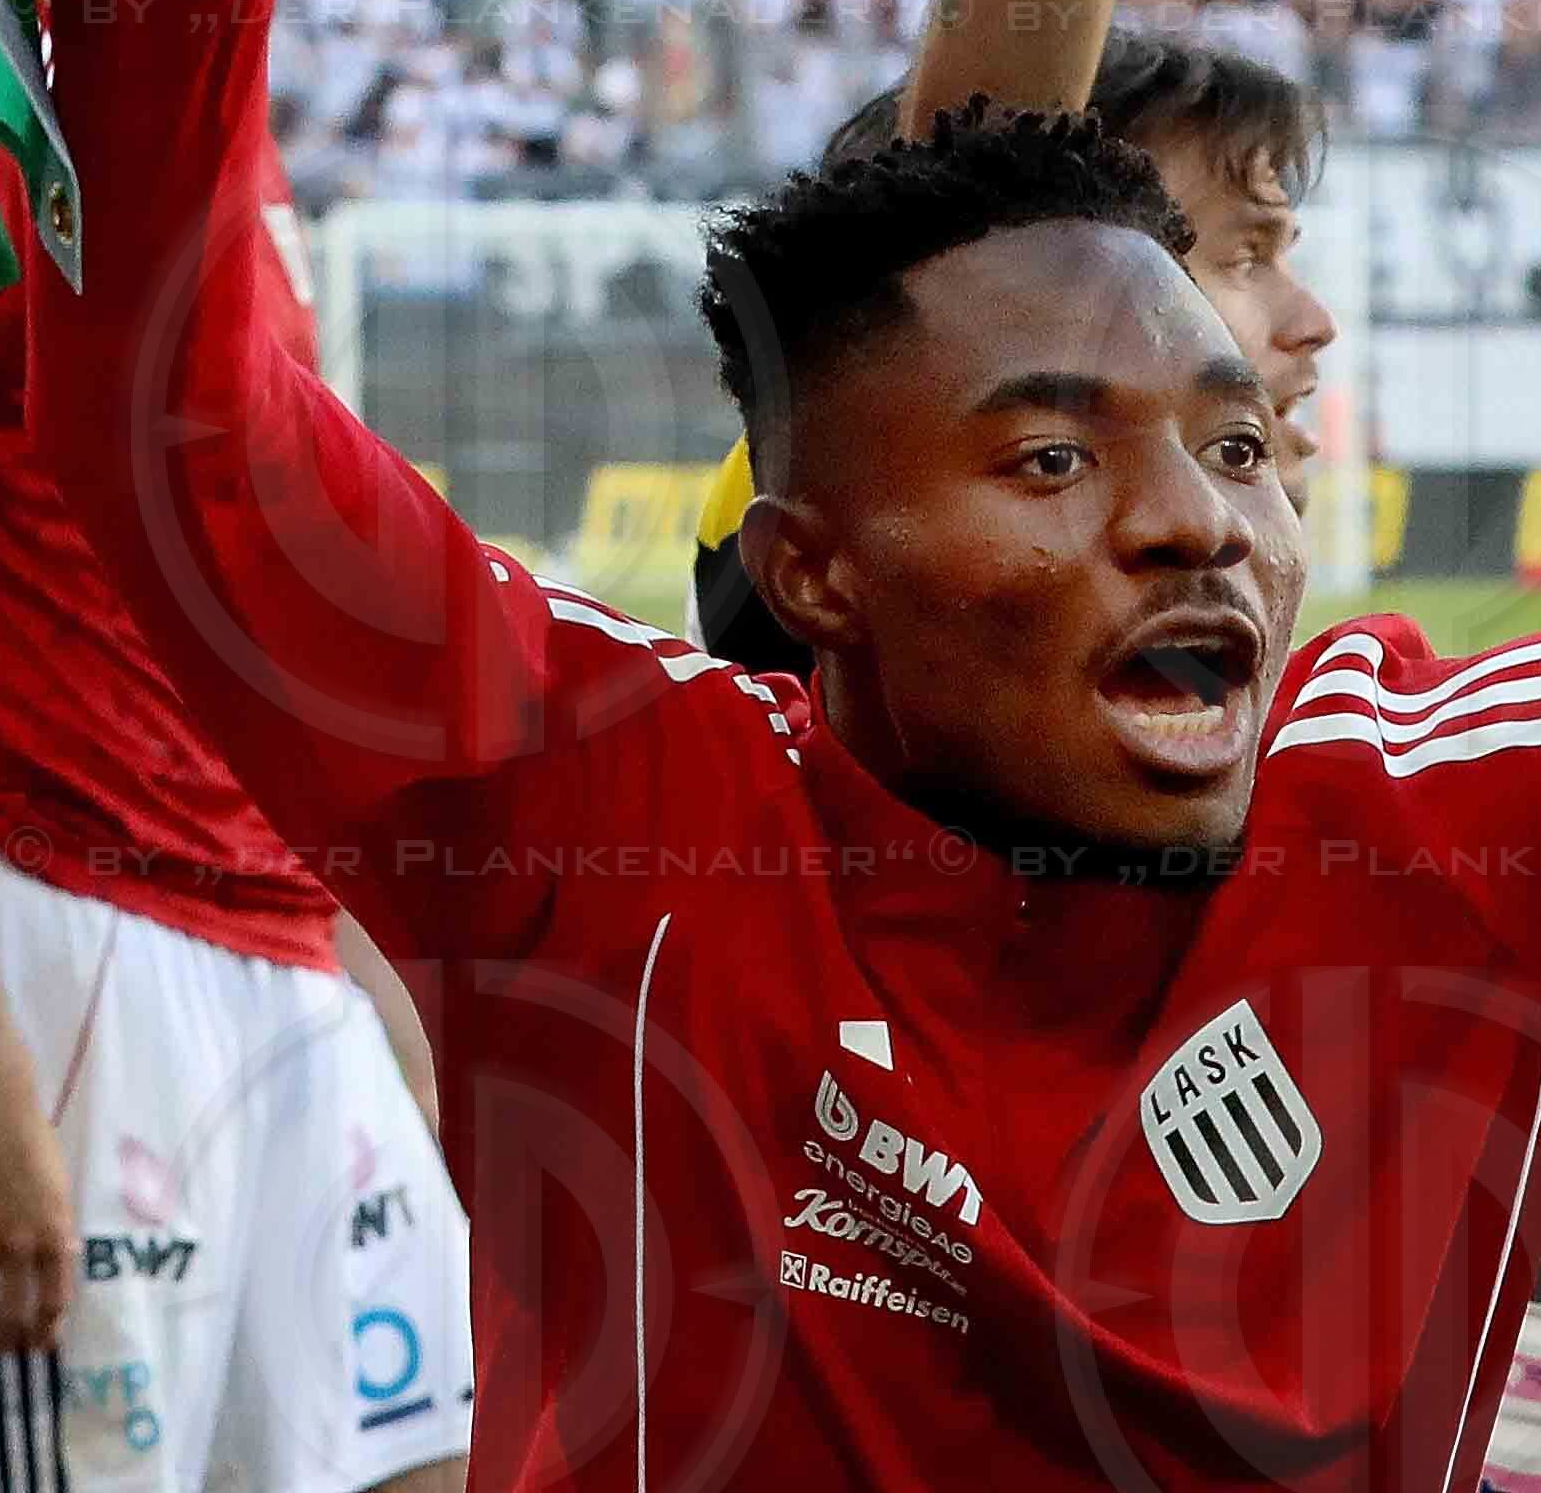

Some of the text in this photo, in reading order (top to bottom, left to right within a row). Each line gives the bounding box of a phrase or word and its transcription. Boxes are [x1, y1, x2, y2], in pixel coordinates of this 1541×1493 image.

[1150, 1024, 1260, 1125] LASK
[859, 1119, 983, 1226] BWT
[808, 1262, 970, 1334] Raiffeisen
